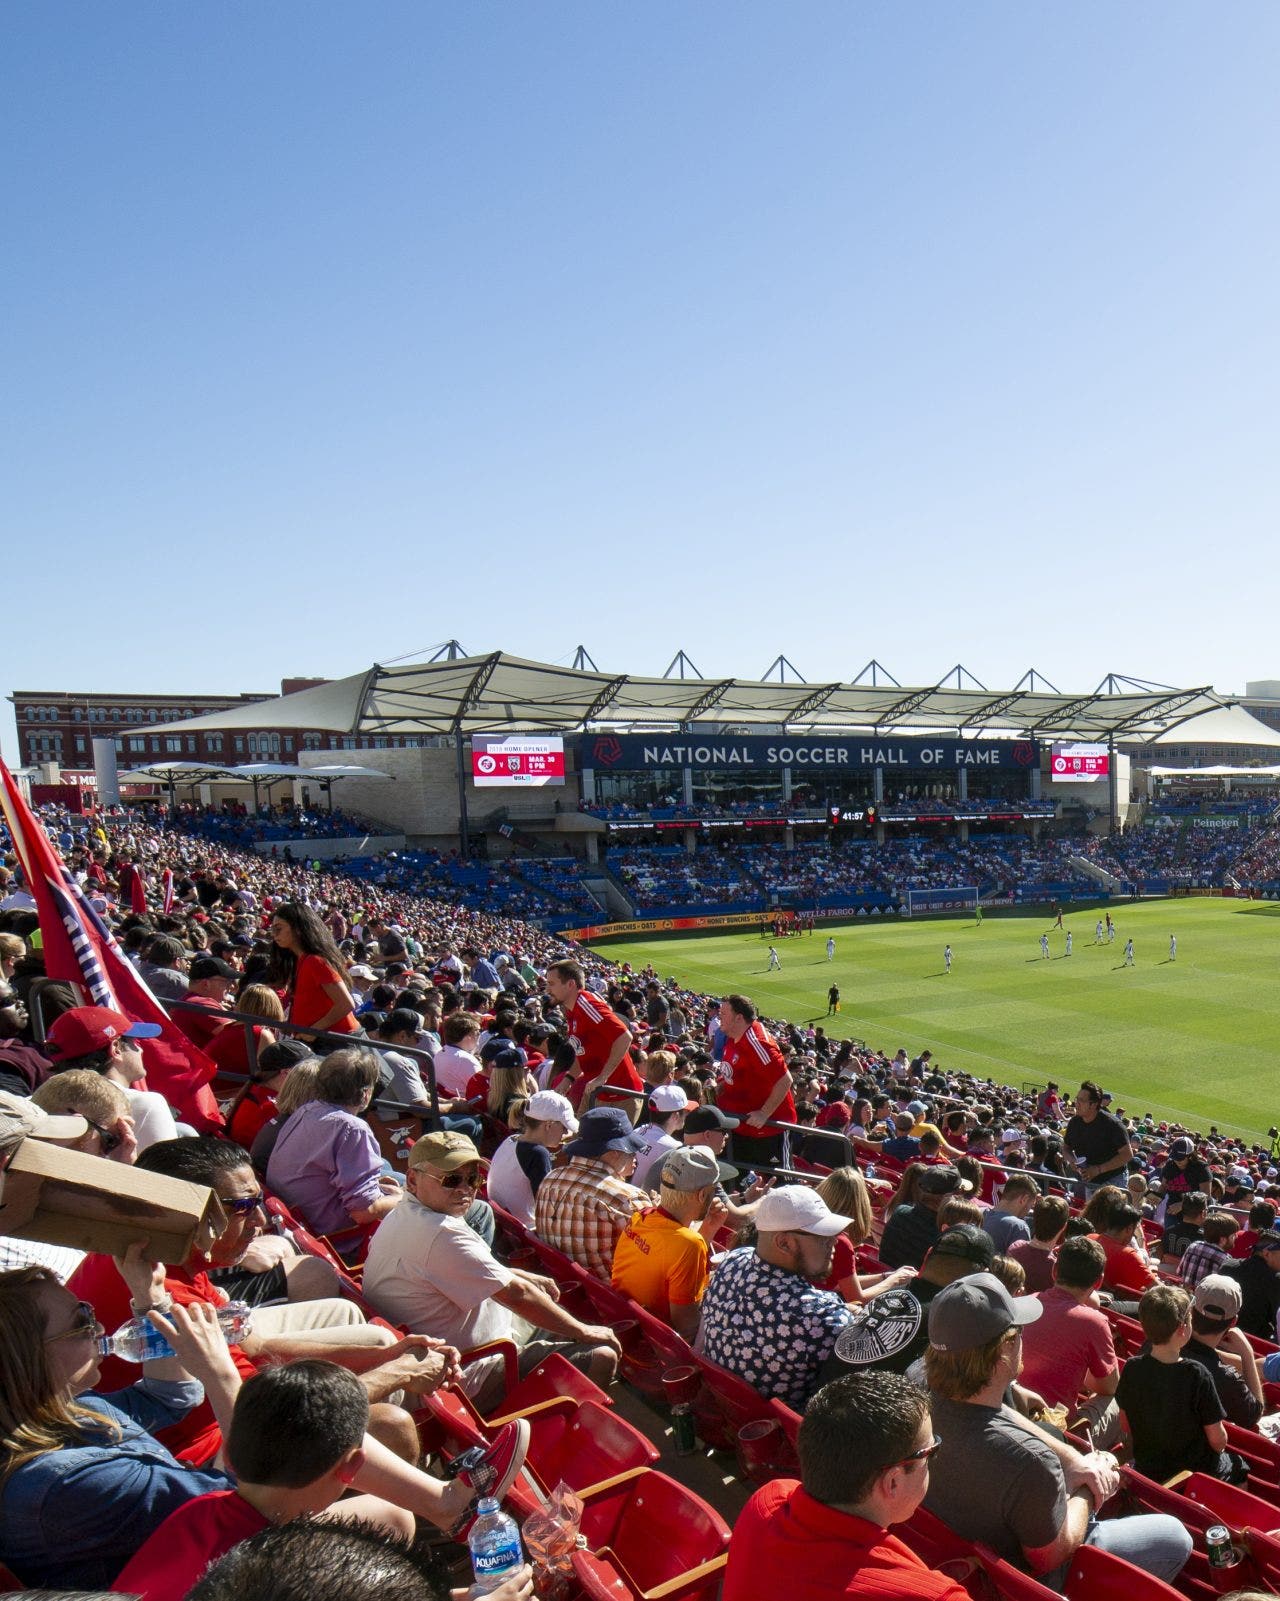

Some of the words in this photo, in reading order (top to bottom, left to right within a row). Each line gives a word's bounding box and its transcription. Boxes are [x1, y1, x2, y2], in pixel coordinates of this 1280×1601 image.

[643, 746, 755, 764] NATIONAL
[767, 746, 849, 764] SOCCER
[860, 747, 909, 764] HALL
[920, 747, 945, 764] OF
[955, 748, 1000, 765] FAME
[70, 775, 78, 785] 3
[842, 812, 864, 820] 41:57
[798, 909, 826, 918] WELLS
[827, 907, 854, 916] FARGO
[876, 1320, 913, 1350] KINGS
[476, 1549, 517, 1568] AQUAFINA
